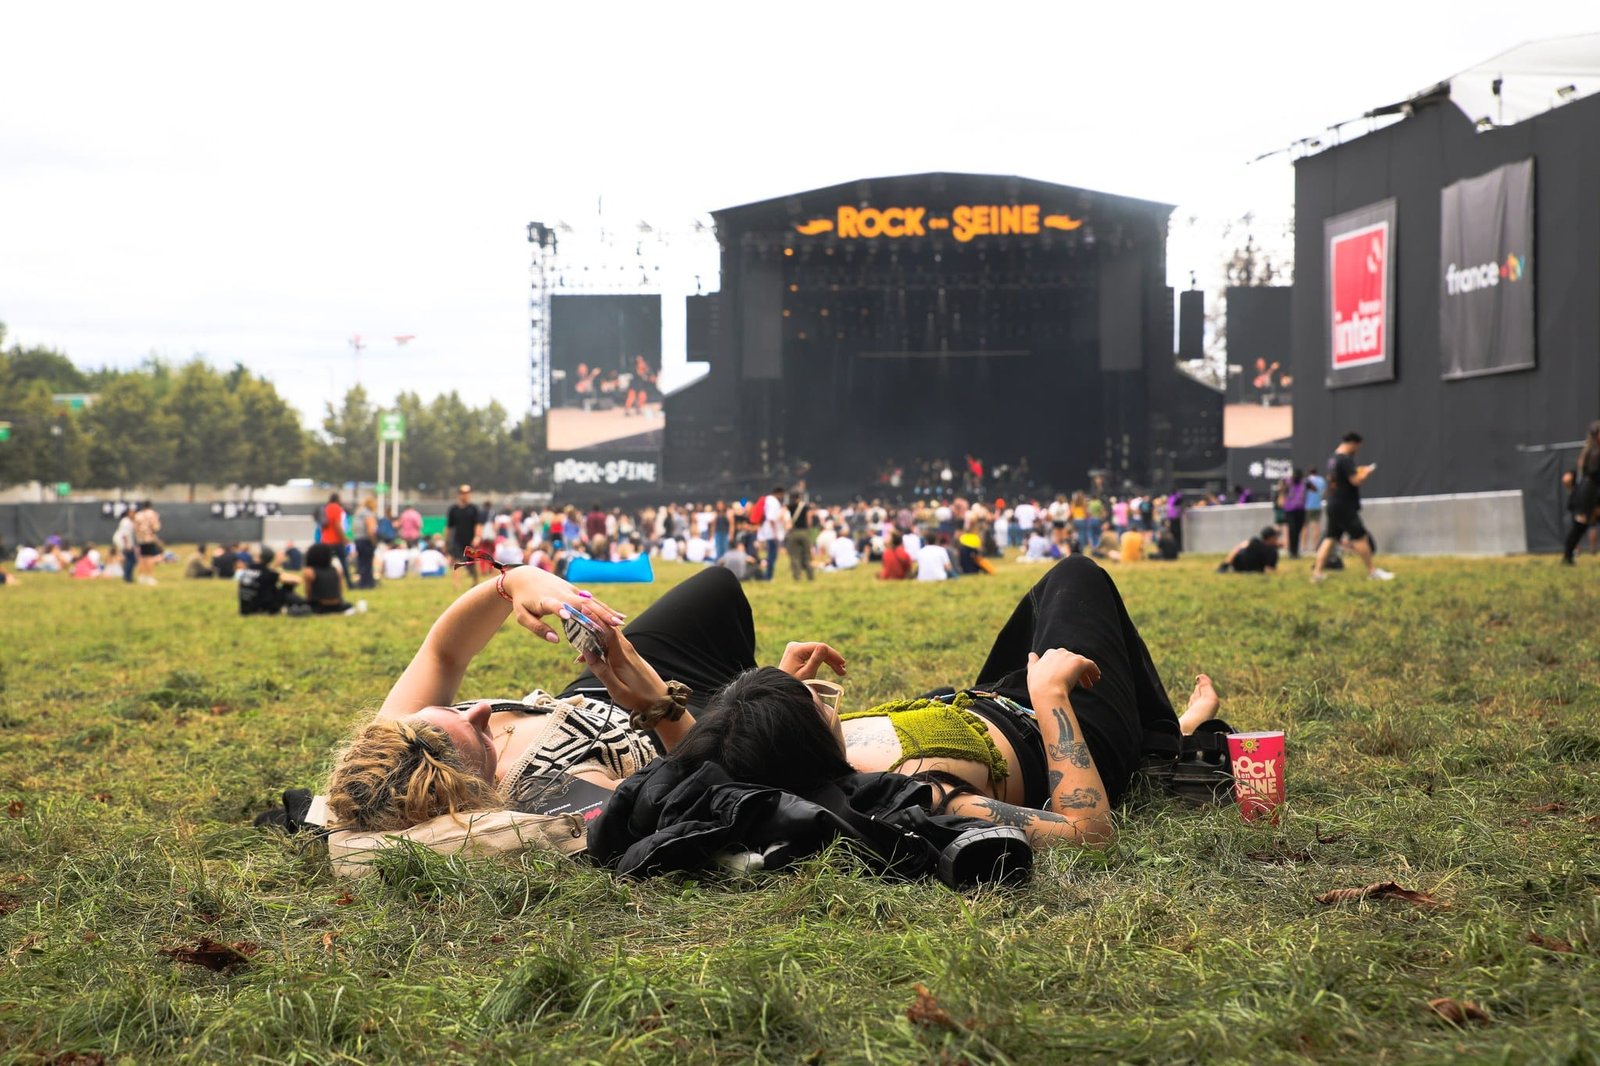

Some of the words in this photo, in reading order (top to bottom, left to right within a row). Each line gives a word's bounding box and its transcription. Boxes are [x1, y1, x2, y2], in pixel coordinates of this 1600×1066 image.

[837, 205, 926, 238] ROCK
[952, 204, 1040, 242] SEINE
[1446, 262, 1500, 296] france
[1335, 309, 1381, 356] inter
[1232, 756, 1276, 779] ROCK
[1235, 778, 1277, 799] SEINE
